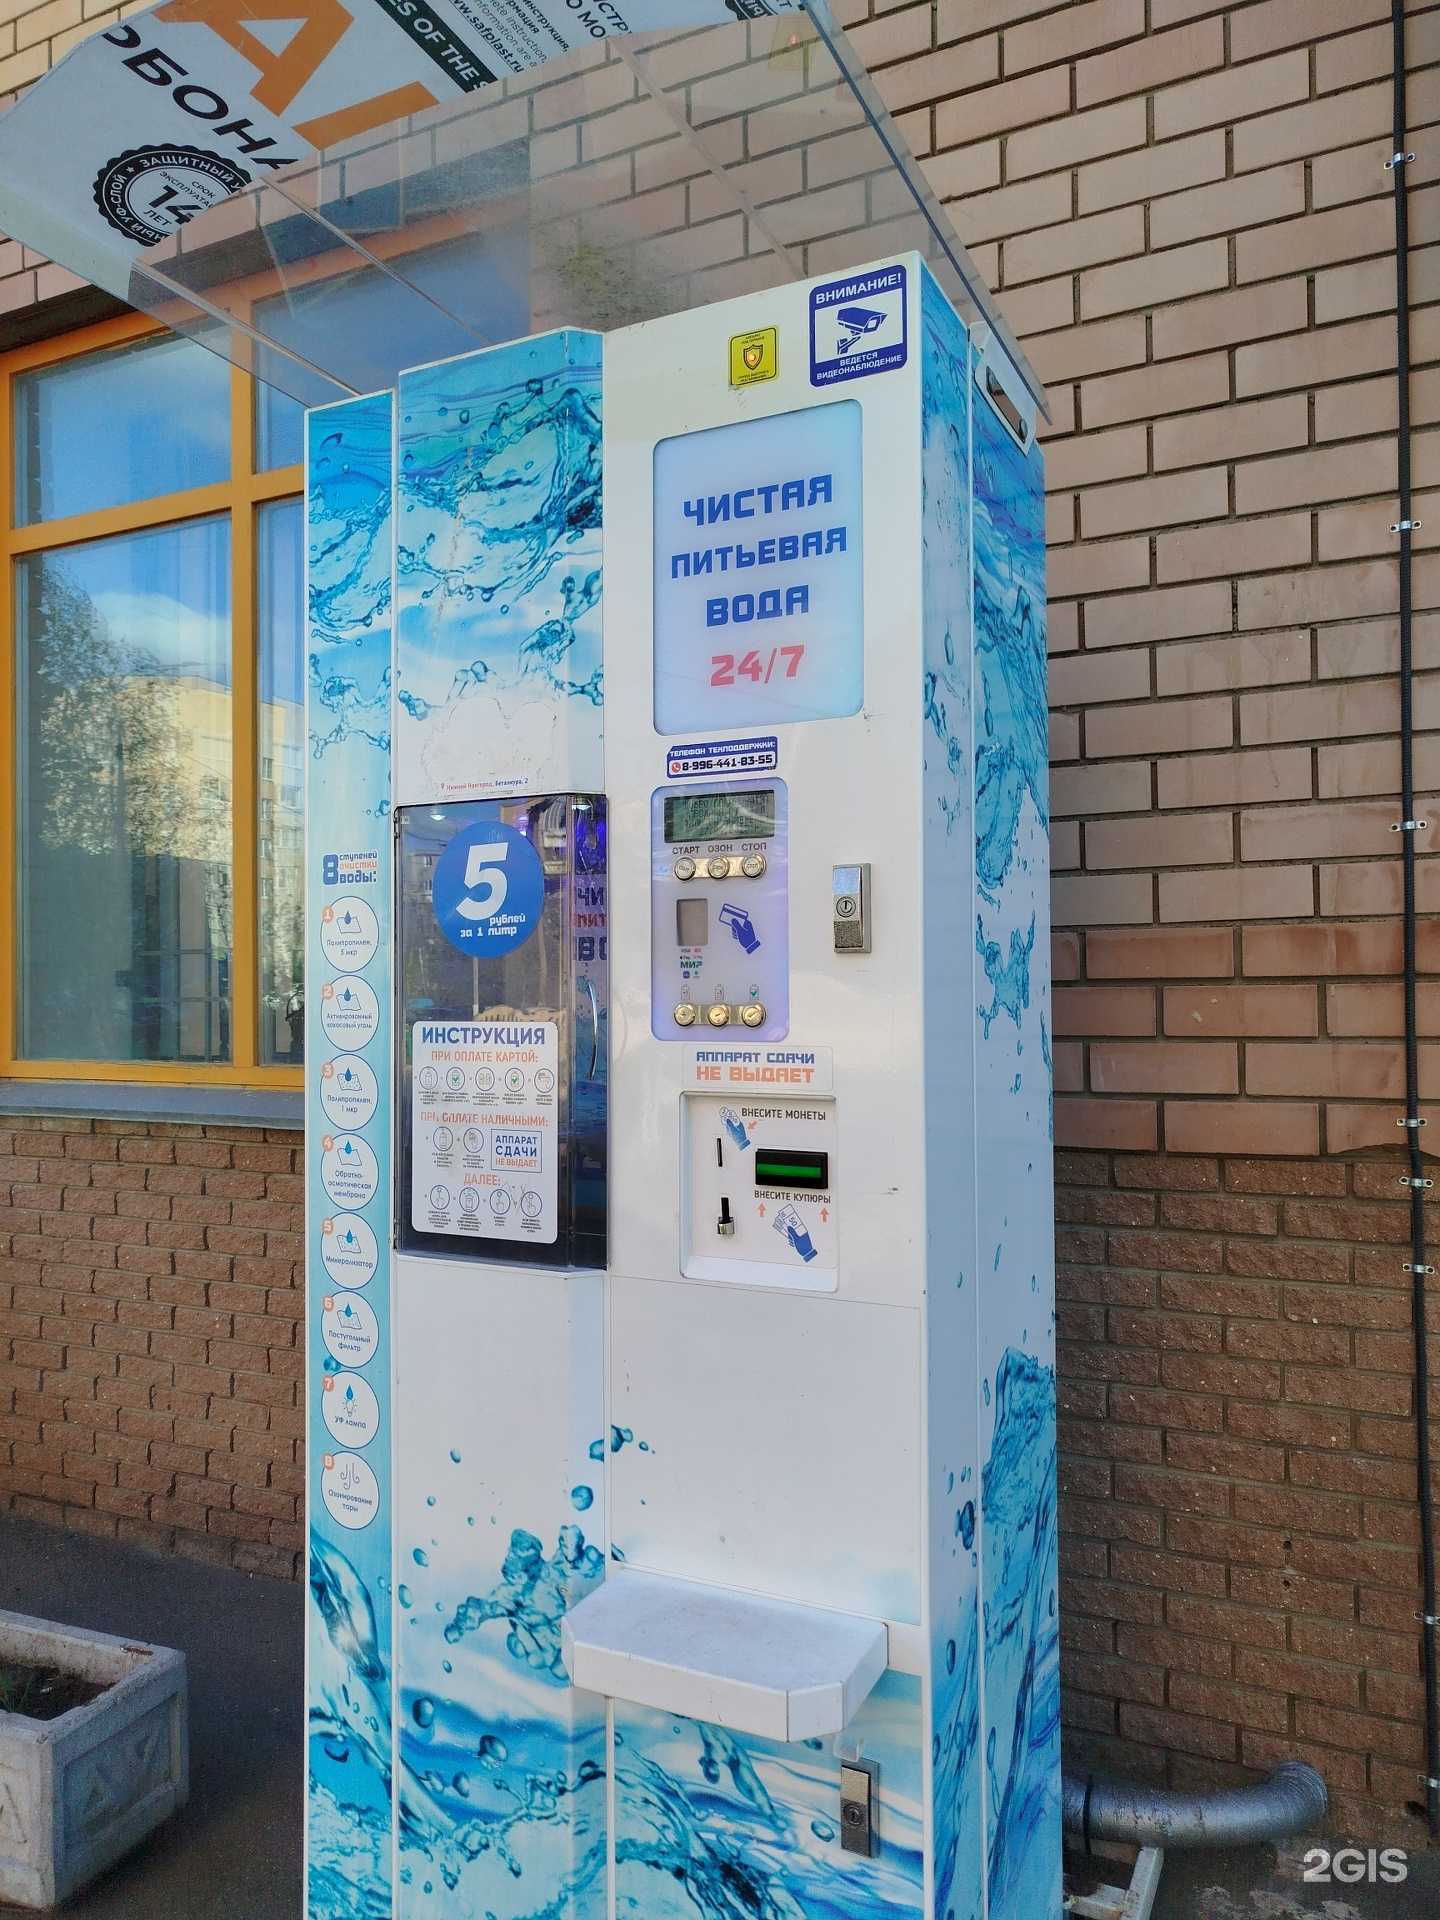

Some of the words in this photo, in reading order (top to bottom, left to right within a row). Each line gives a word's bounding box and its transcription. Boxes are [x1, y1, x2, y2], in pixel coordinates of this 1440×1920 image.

[504, 0, 540, 34] рмация
[413, 17, 446, 43] OF
[440, 43, 480, 81] THE
[139, 155, 235, 183] ЗАЩИТНЫЙ
[192, 181, 217, 199] СРОК
[148, 185, 203, 224] 14
[143, 209, 172, 226] ЛЕТ
[816, 273, 901, 305] ВНИМАНИЕ!
[839, 352, 878, 366] ВЕДЕТСЯ
[816, 355, 903, 380] ВИДЕОНАБЛЮДЕНИЕ
[683, 474, 832, 527] ЧИСТАЯ
[671, 526, 847, 579] ПИТЬЕВАЯ
[706, 584, 809, 627] ВОДА
[710, 644, 805, 687] 24/7
[669, 747, 706, 758] ТЕЛЕФОН
[709, 741, 776, 754] ТЕХПОДДЕРЖКИ:
[682, 754, 773, 771] 8-996-441-83-55
[672, 845, 700, 855] СТАРТ
[708, 844, 733, 853] ОЗОН
[741, 842, 767, 851] СТОП
[339, 851, 378, 861] ступеней
[322, 853, 339, 885] 8
[339, 861, 378, 870] очистки
[339, 870, 377, 884] воды:
[455, 842, 509, 921] 5
[489, 913, 526, 927] рублей
[460, 929, 473, 938] за
[477, 927, 483, 937] 1
[488, 926, 517, 937] литр
[422, 1026, 545, 1047] ИНСТРУКЦИЯ
[431, 1050, 451, 1061] ПРИ
[454, 1051, 493, 1062] ОПЛАТЕ
[495, 1049, 538, 1063] КАРТОЙ:
[696, 1051, 761, 1063] АППАРАТ
[766, 1052, 815, 1064] СДАЧИ
[696, 1065, 721, 1081] НЕ
[729, 1066, 815, 1083] ВЫДАЕТ
[442, 1112, 479, 1123] ОПЛАТЕ
[481, 1113, 549, 1127] НАЛИЧНЫМИ:
[741, 1107, 783, 1119] ВНЕСИТЕ
[785, 1109, 826, 1121] МОНЕТЫ
[495, 1135, 537, 1145] АППАРАТ
[495, 1145, 537, 1158] СДАЧИ
[495, 1157, 506, 1167] НЕ
[506, 1158, 537, 1168] ВЫДАЕТ
[463, 1172, 501, 1186] ДАЛЕЕ:
[754, 1189, 791, 1201] ВНЕСИТЕ
[793, 1193, 831, 1204] КУПЮРЫ
